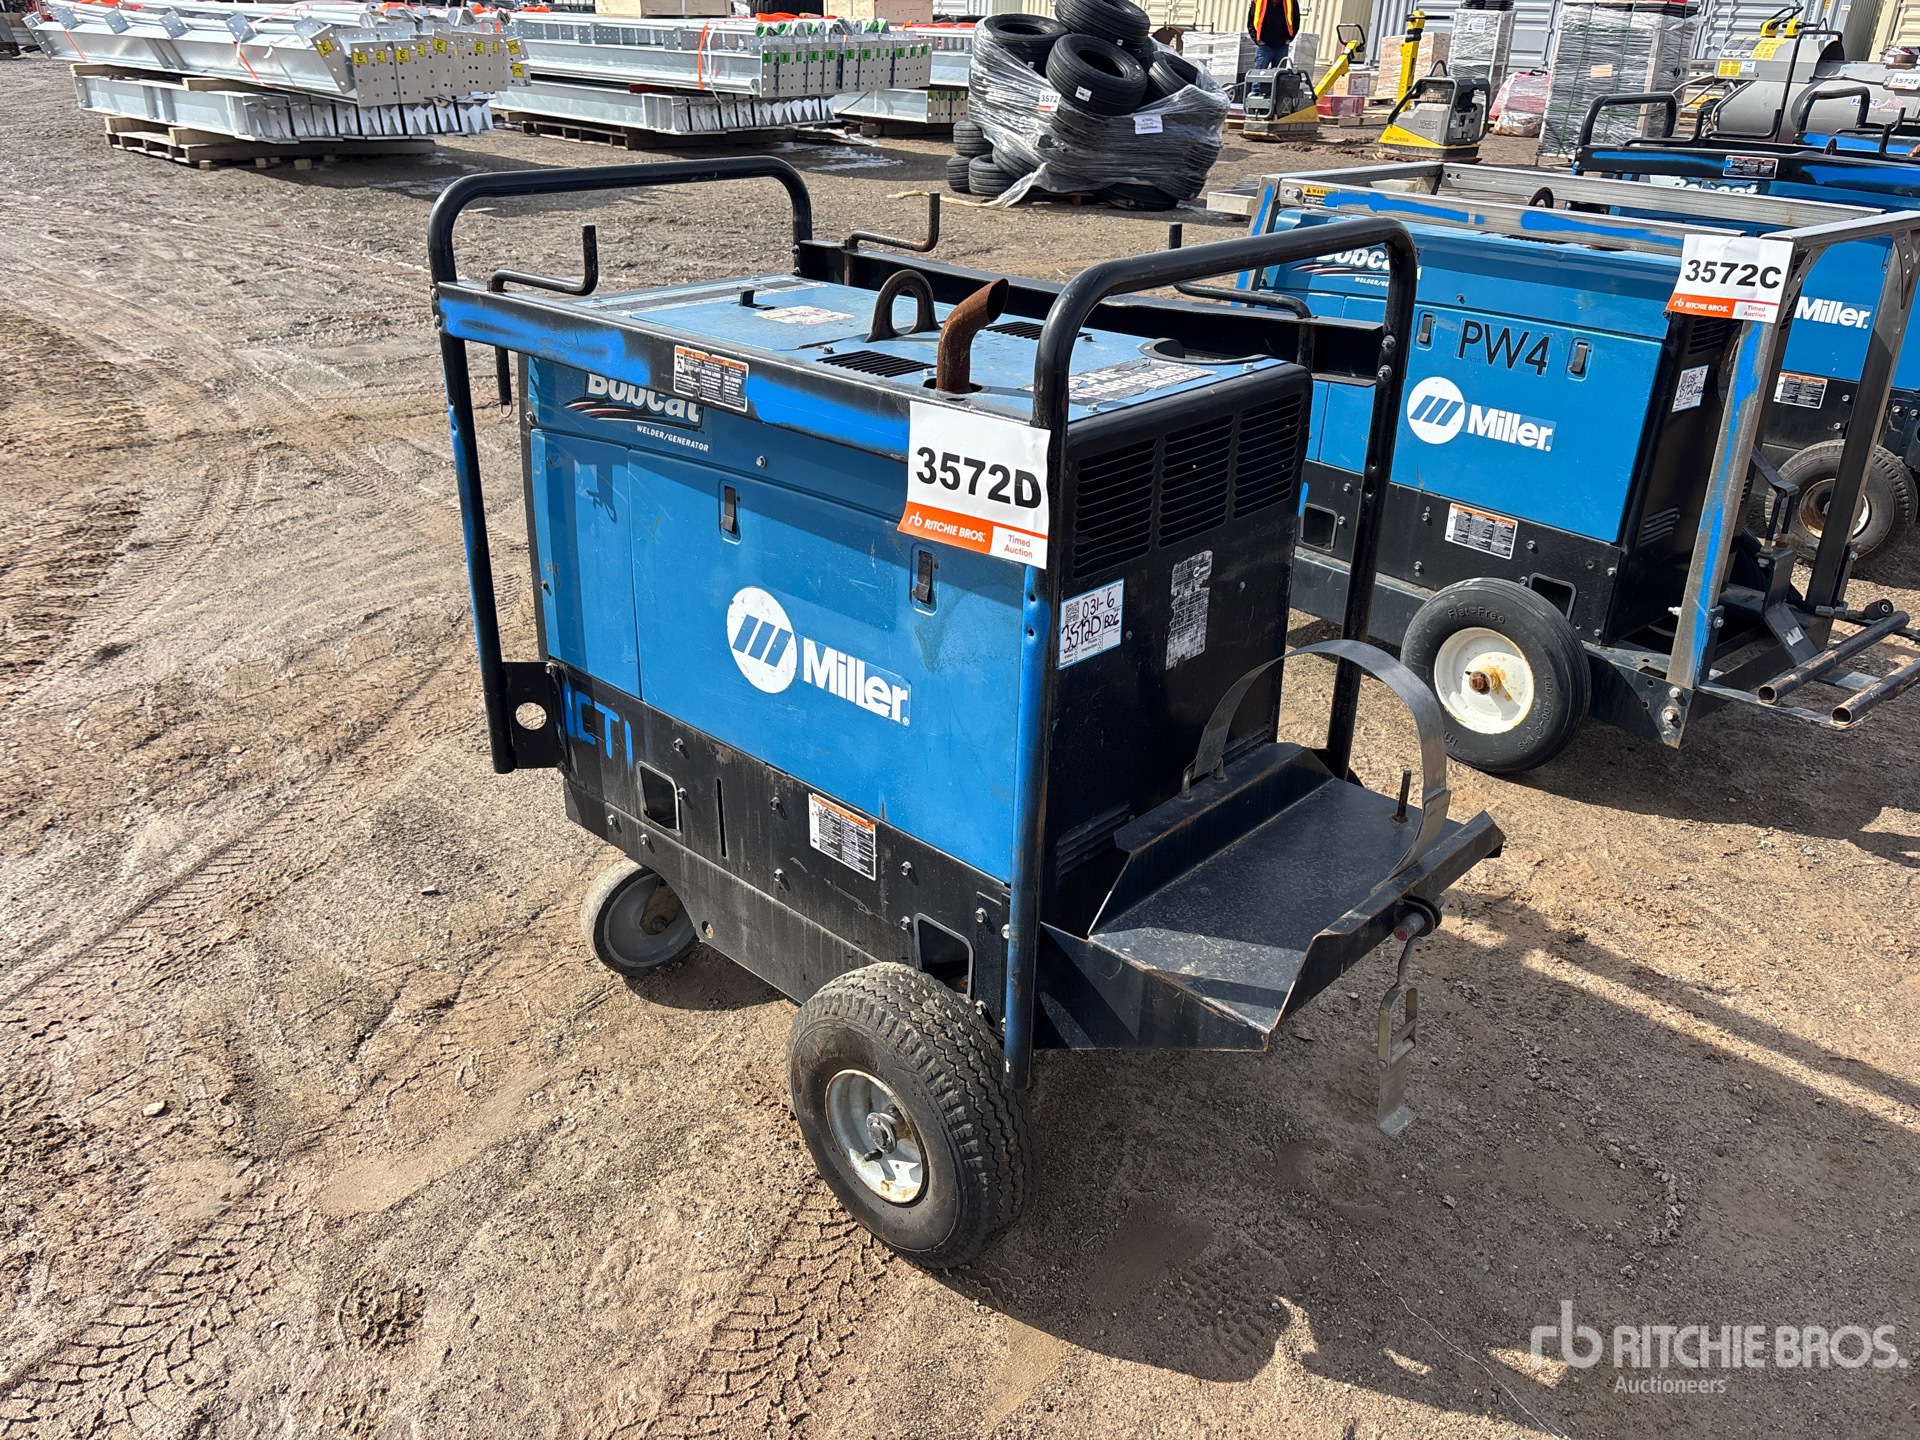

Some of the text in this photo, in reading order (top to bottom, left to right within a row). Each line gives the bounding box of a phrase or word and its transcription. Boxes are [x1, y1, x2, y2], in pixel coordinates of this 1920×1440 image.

[1041, 94, 1059, 103] 3572
[1684, 259, 1782, 290] 3572C
[1685, 302, 1708, 311] RITCHIE
[1747, 305, 1766, 313] Timed
[1458, 320, 1550, 376] PW4
[636, 424, 709, 452] WELDER/GENERATOR
[916, 446, 1042, 509] 3572D
[923, 518, 958, 536] RITCHIE
[1008, 534, 1031, 548] Timed
[1003, 544, 1033, 558] Auction
[1447, 606, 1506, 625] Flat-Free
